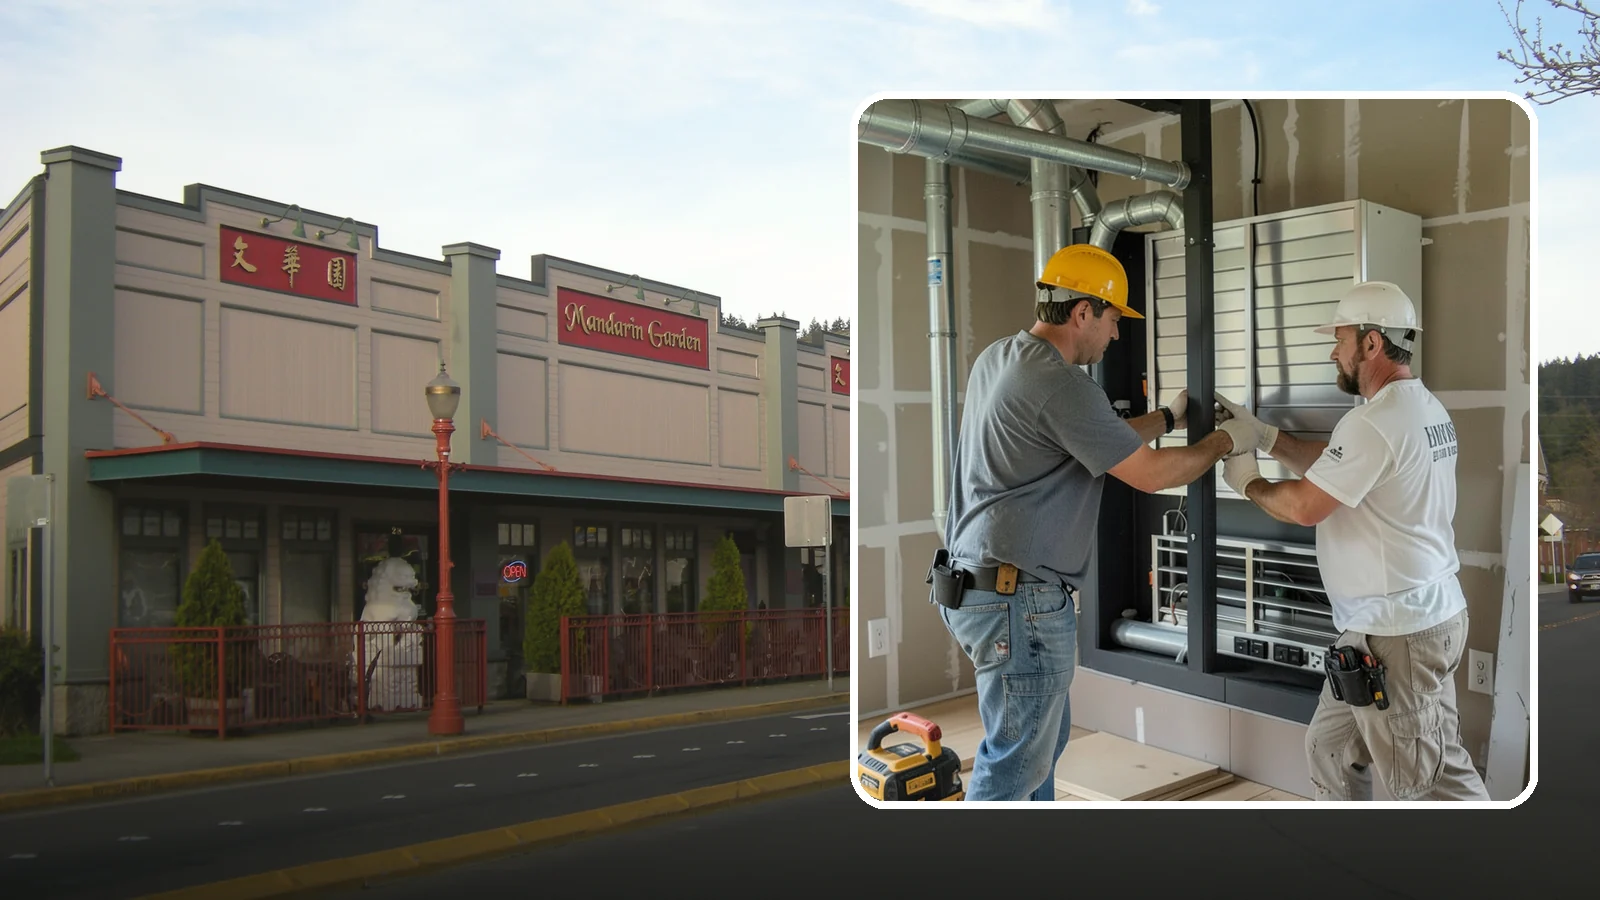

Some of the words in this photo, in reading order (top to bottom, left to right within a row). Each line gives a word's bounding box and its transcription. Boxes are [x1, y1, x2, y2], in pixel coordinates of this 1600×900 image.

[230, 235, 347, 291] 文華園
[564, 302, 644, 341] Mandarin
[647, 320, 702, 352] Garden
[503, 565, 527, 578] OPEN
